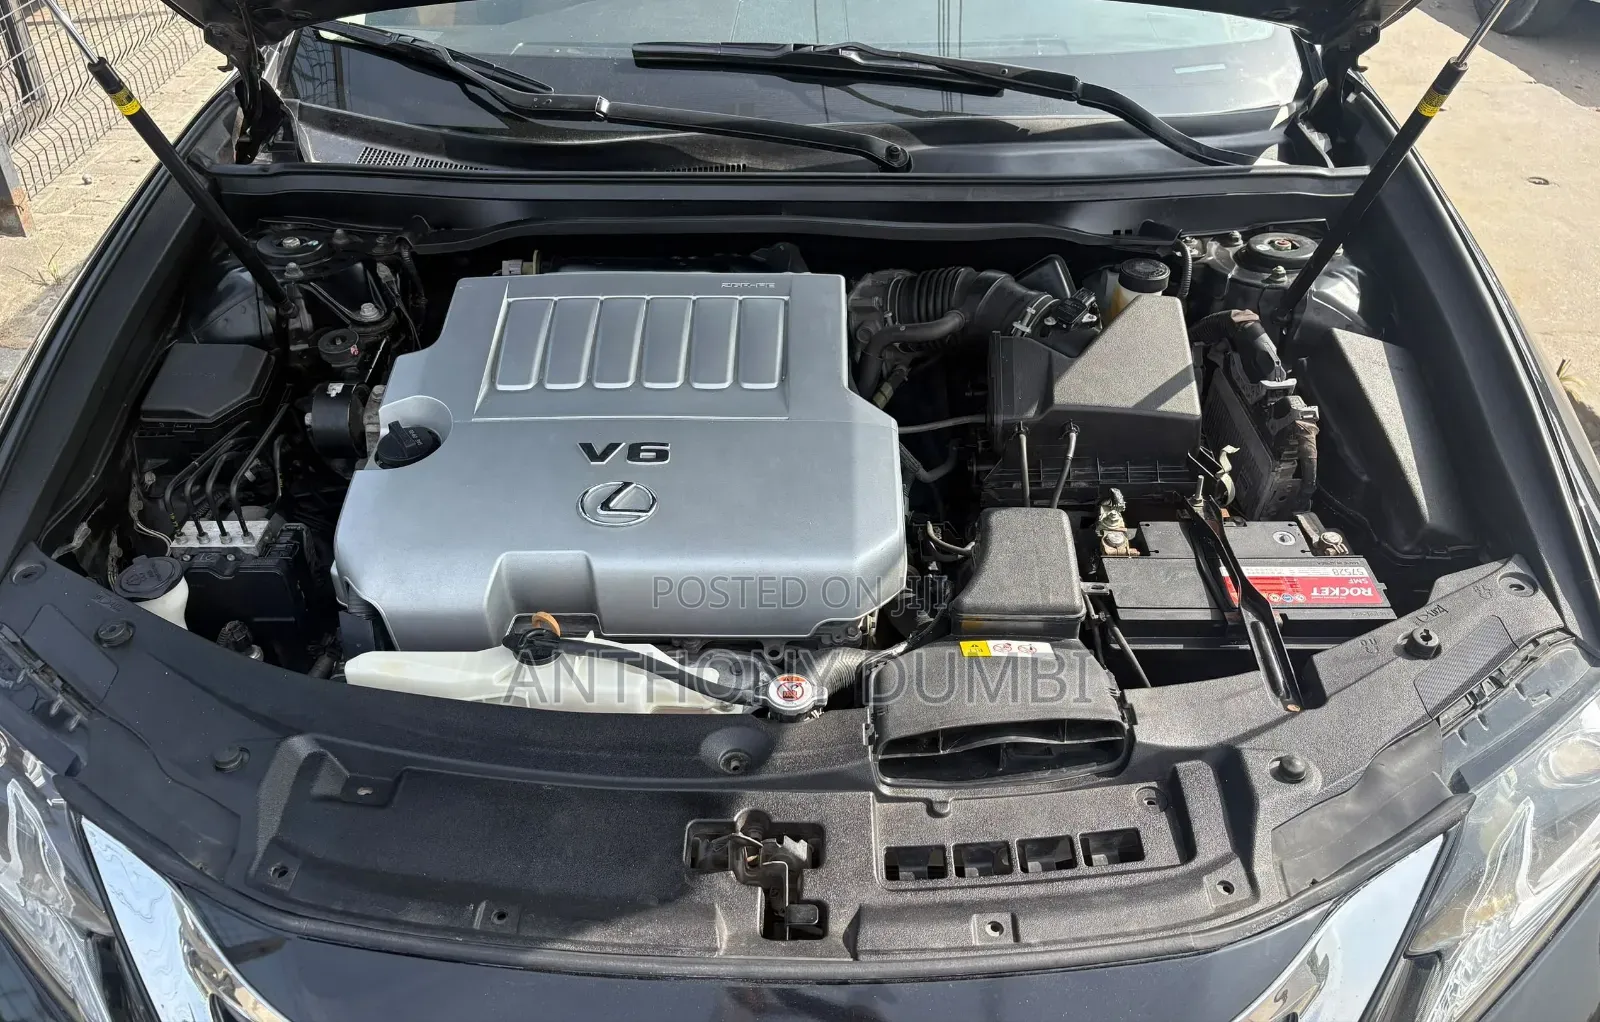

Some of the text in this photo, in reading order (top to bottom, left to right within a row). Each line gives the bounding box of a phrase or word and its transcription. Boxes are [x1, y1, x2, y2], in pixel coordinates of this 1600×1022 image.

[577, 442, 671, 465] V6
[1332, 568, 1364, 576] 57528
[1310, 586, 1374, 597] ROCKET
